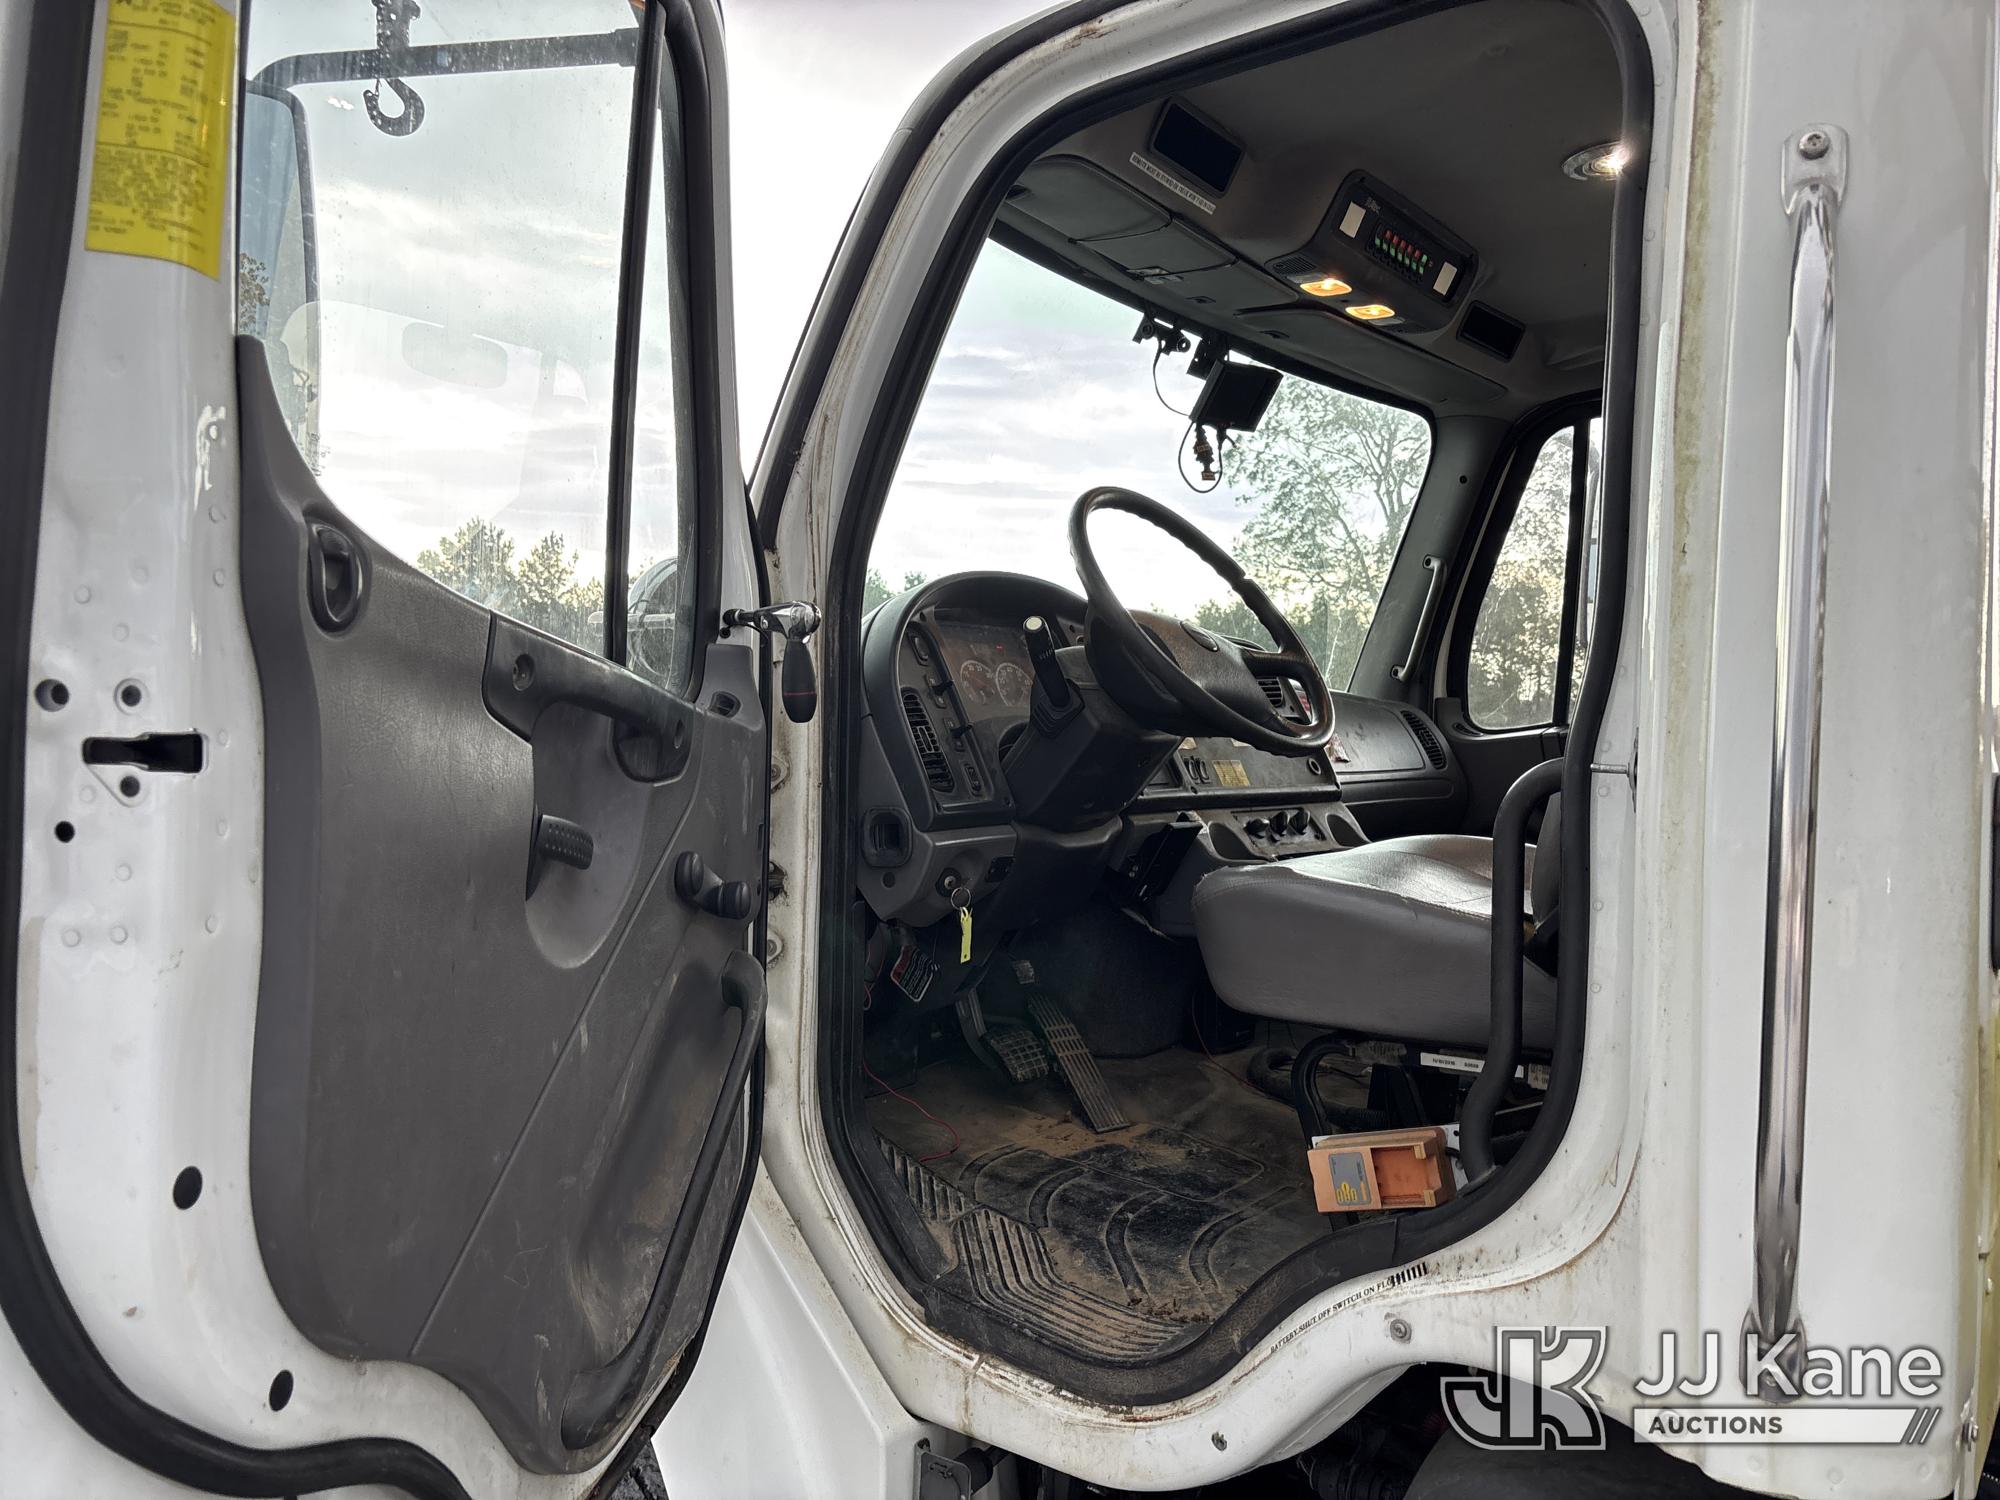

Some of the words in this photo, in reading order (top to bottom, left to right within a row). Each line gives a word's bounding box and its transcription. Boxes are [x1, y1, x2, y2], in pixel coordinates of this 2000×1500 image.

[1270, 1329, 1298, 1354] BATTERY
[1298, 1315, 1317, 1332] SHUT
[1318, 1308, 1331, 1320] OFF
[1332, 1291, 1362, 1311] SWITCH
[1363, 1286, 1375, 1297] ON
